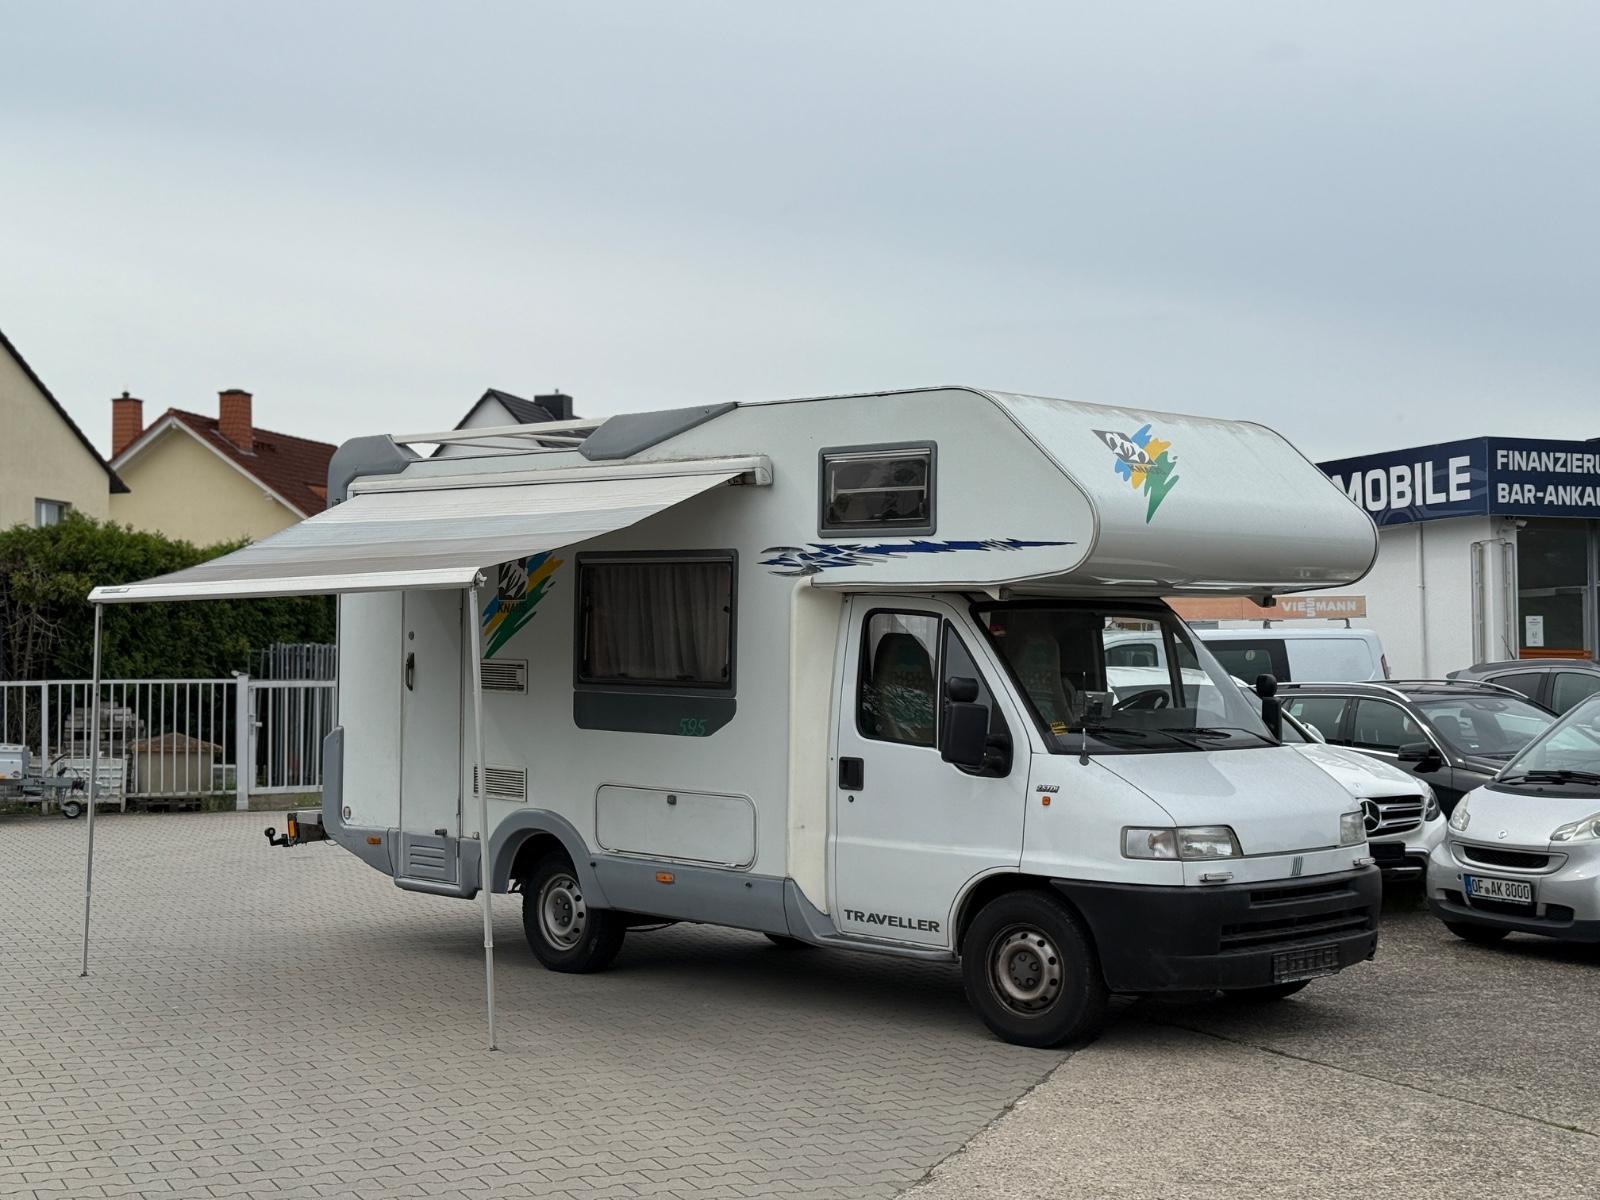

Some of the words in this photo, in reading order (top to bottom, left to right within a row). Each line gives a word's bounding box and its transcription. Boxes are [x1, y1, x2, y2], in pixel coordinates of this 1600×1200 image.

[1332, 455, 1471, 512] MOBILE
[1280, 597, 1357, 617] VIESSMANN
[1472, 879, 1483, 894] OF
[1491, 881, 1503, 896] AK
[1505, 883, 1529, 899] 8000
[844, 909, 940, 933] TRAVELLER
